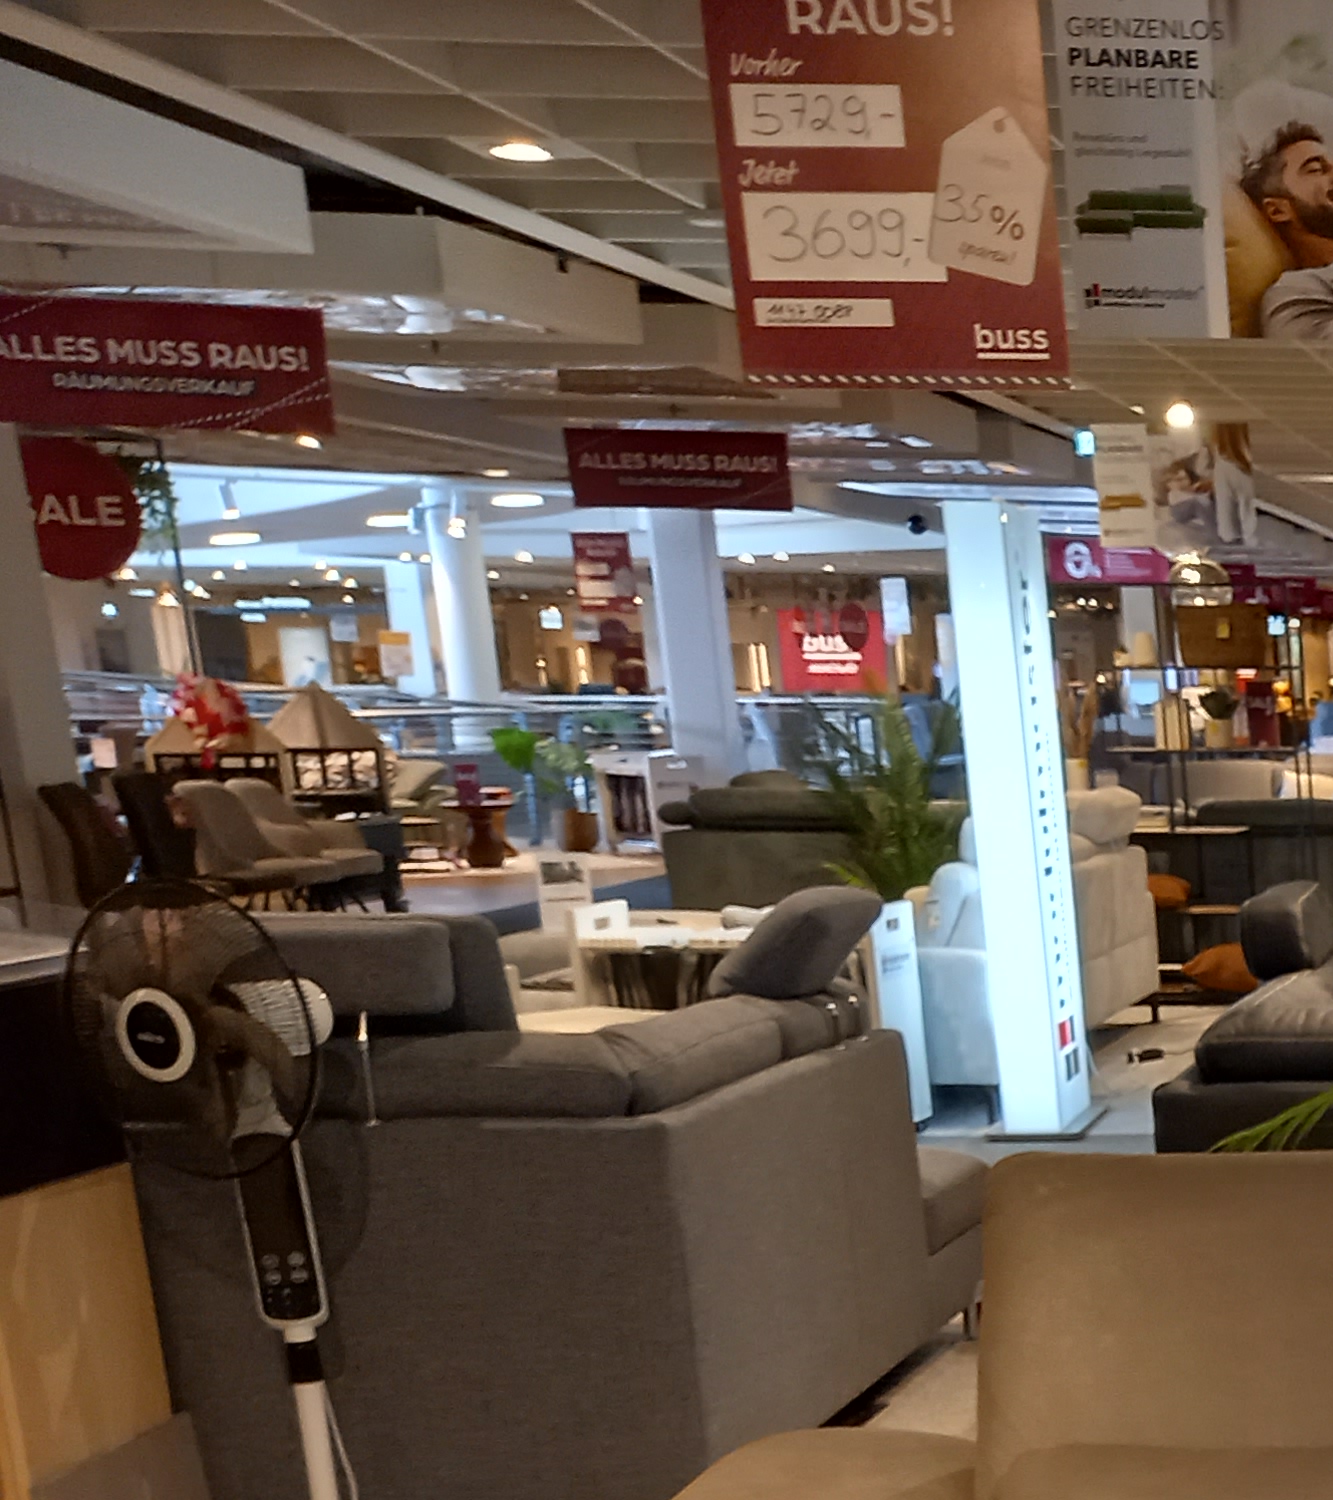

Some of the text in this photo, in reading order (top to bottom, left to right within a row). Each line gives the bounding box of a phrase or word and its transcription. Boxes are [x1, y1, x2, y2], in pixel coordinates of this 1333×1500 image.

[786, 0, 955, 37] RAUS!
[1065, 15, 1225, 41] GRENZENLOS
[730, 48, 802, 77] Vorher
[1067, 47, 1199, 69] PLANBARE
[972, 323, 1049, 351] buss
[105, 336, 203, 366] MUSS
[207, 342, 311, 372] RAUS!
[578, 451, 778, 473] ALLES MUSS RAUS!
[36, 492, 127, 528] ALE
